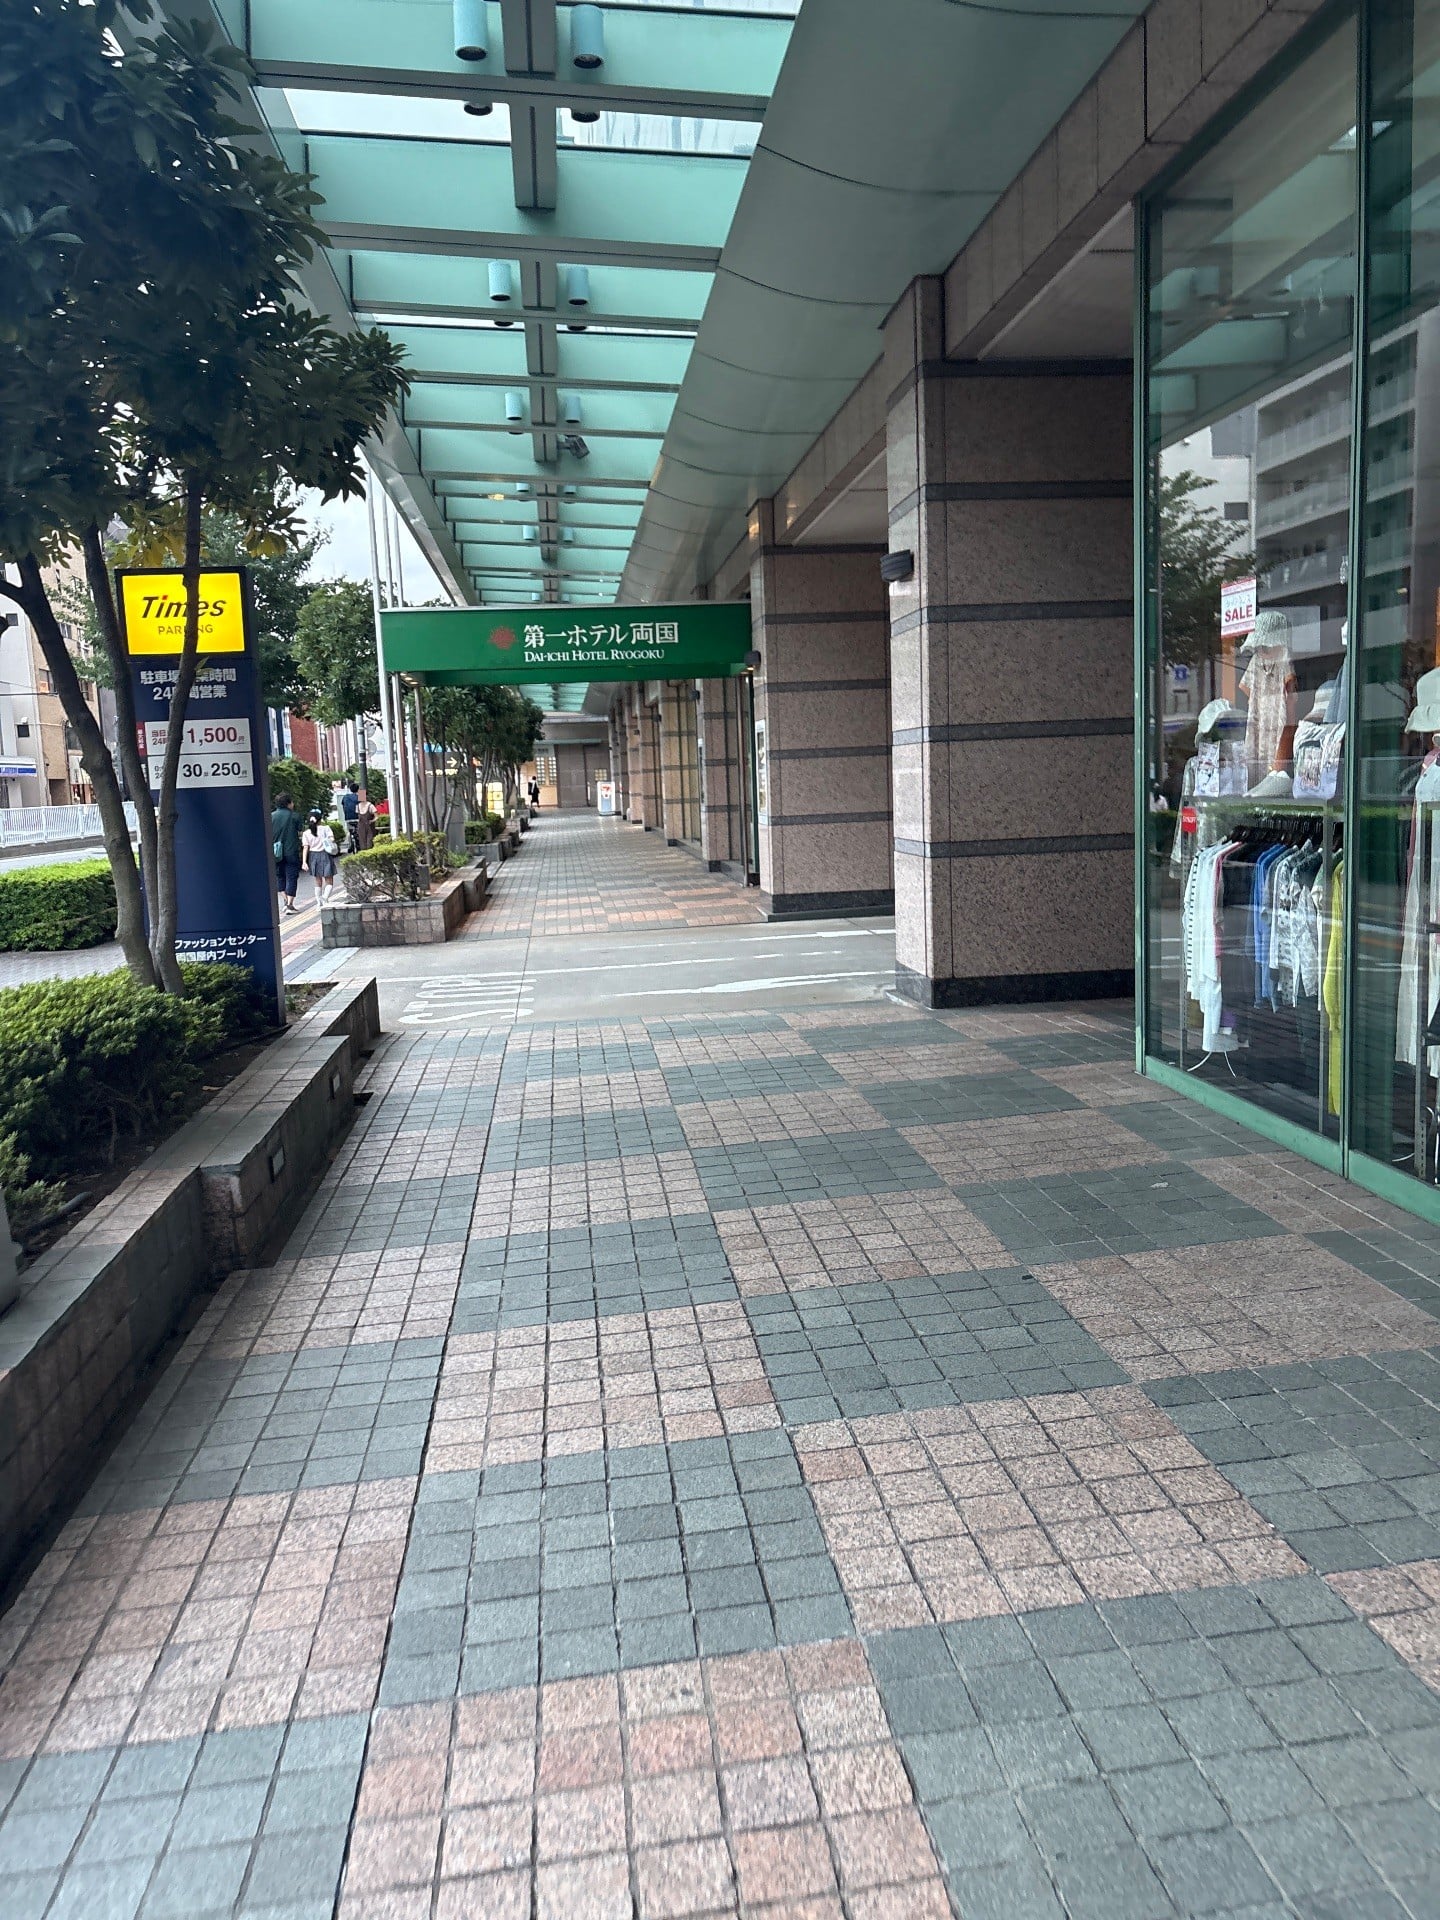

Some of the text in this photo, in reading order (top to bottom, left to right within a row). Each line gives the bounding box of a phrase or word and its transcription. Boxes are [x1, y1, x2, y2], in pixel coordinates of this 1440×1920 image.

[142, 594, 227, 618] Times
[1225, 604, 1253, 623] SALE
[158, 624, 213, 635] PARNG
[523, 622, 679, 648] 第一ホテル両国
[524, 649, 665, 662] DAI-ICHI HOTEL RYOGOKU
[140, 668, 237, 684] 駐車場業時間
[153, 685, 227, 700] 24間営業
[174, 934, 267, 950] ファッションセンター
[397, 978, 537, 1024] STOP
